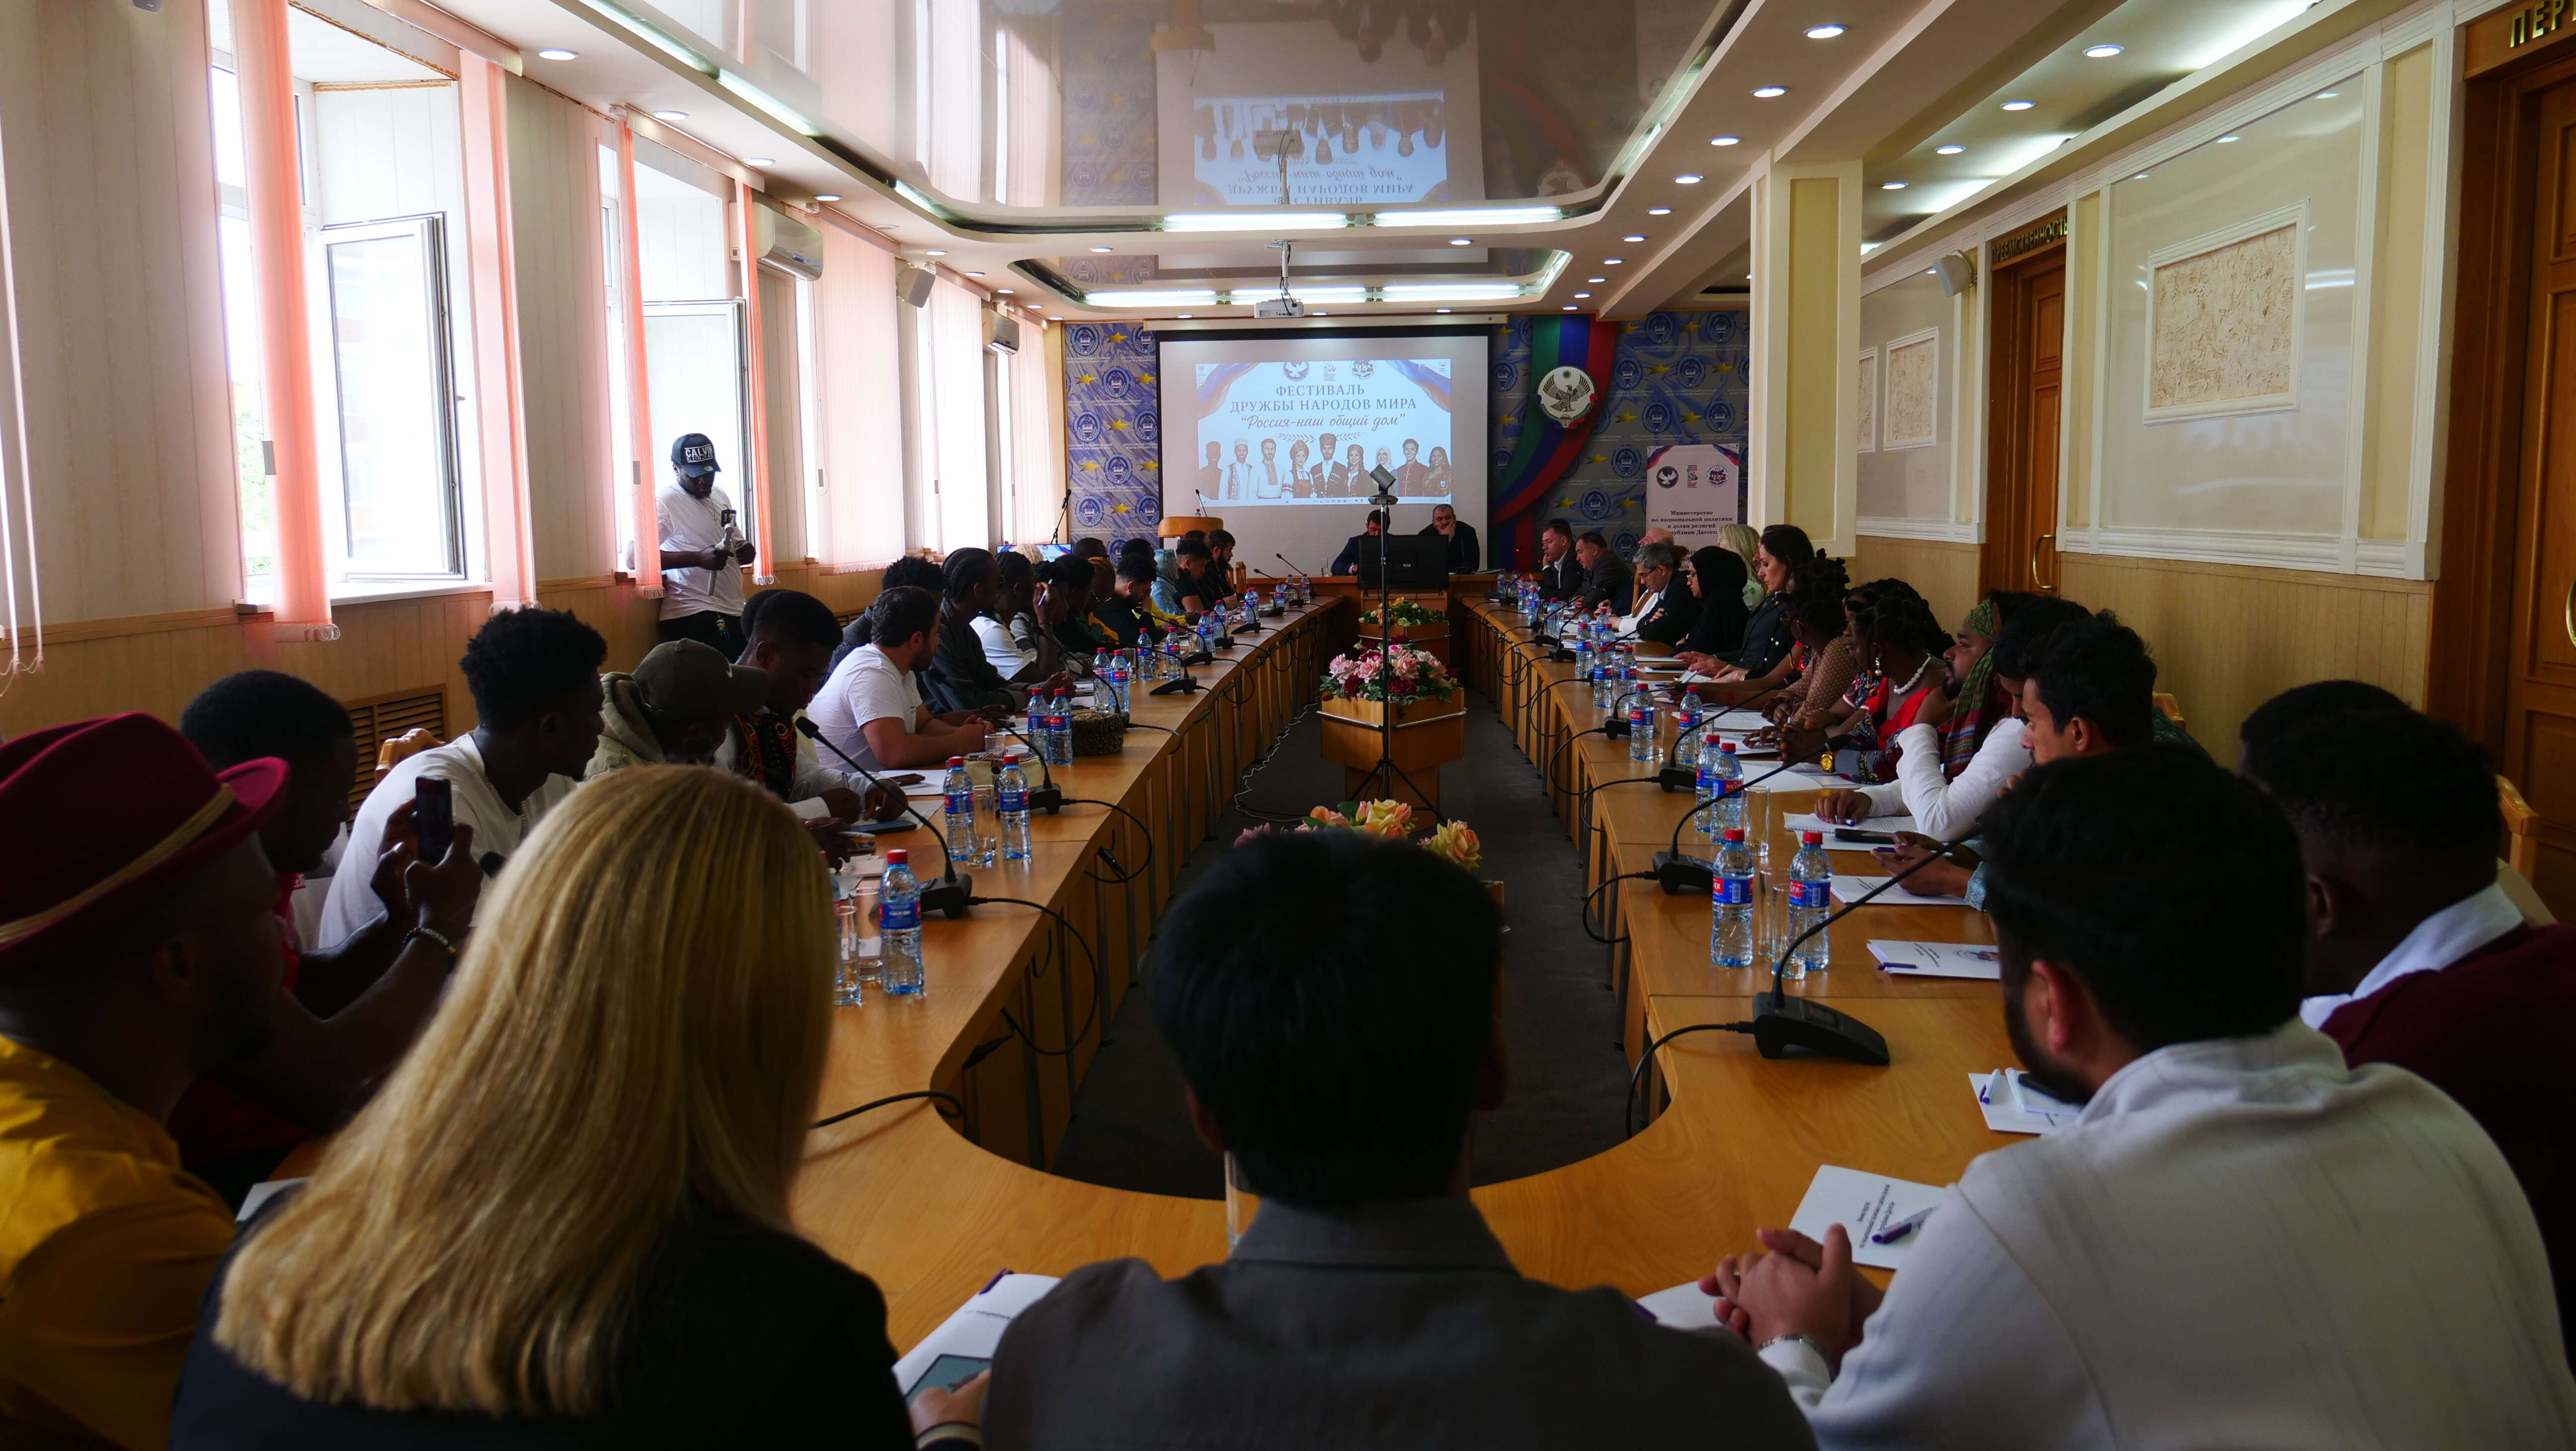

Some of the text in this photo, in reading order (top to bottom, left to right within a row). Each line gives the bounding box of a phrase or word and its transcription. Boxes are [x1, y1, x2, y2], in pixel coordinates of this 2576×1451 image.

[2510, 0, 2576, 48] ПЕР
[1992, 216, 2067, 264] ПРЕЕМСТВЕННОСТЬ
[1276, 385, 1365, 396] ФЕСТИВАЛЬ
[1230, 398, 1417, 413] ДРУЖБЫ НАРОДОВ МИРА
[1330, 414, 1369, 428] общий
[1371, 413, 1405, 431] дом”
[686, 445, 713, 458] CALVIN
